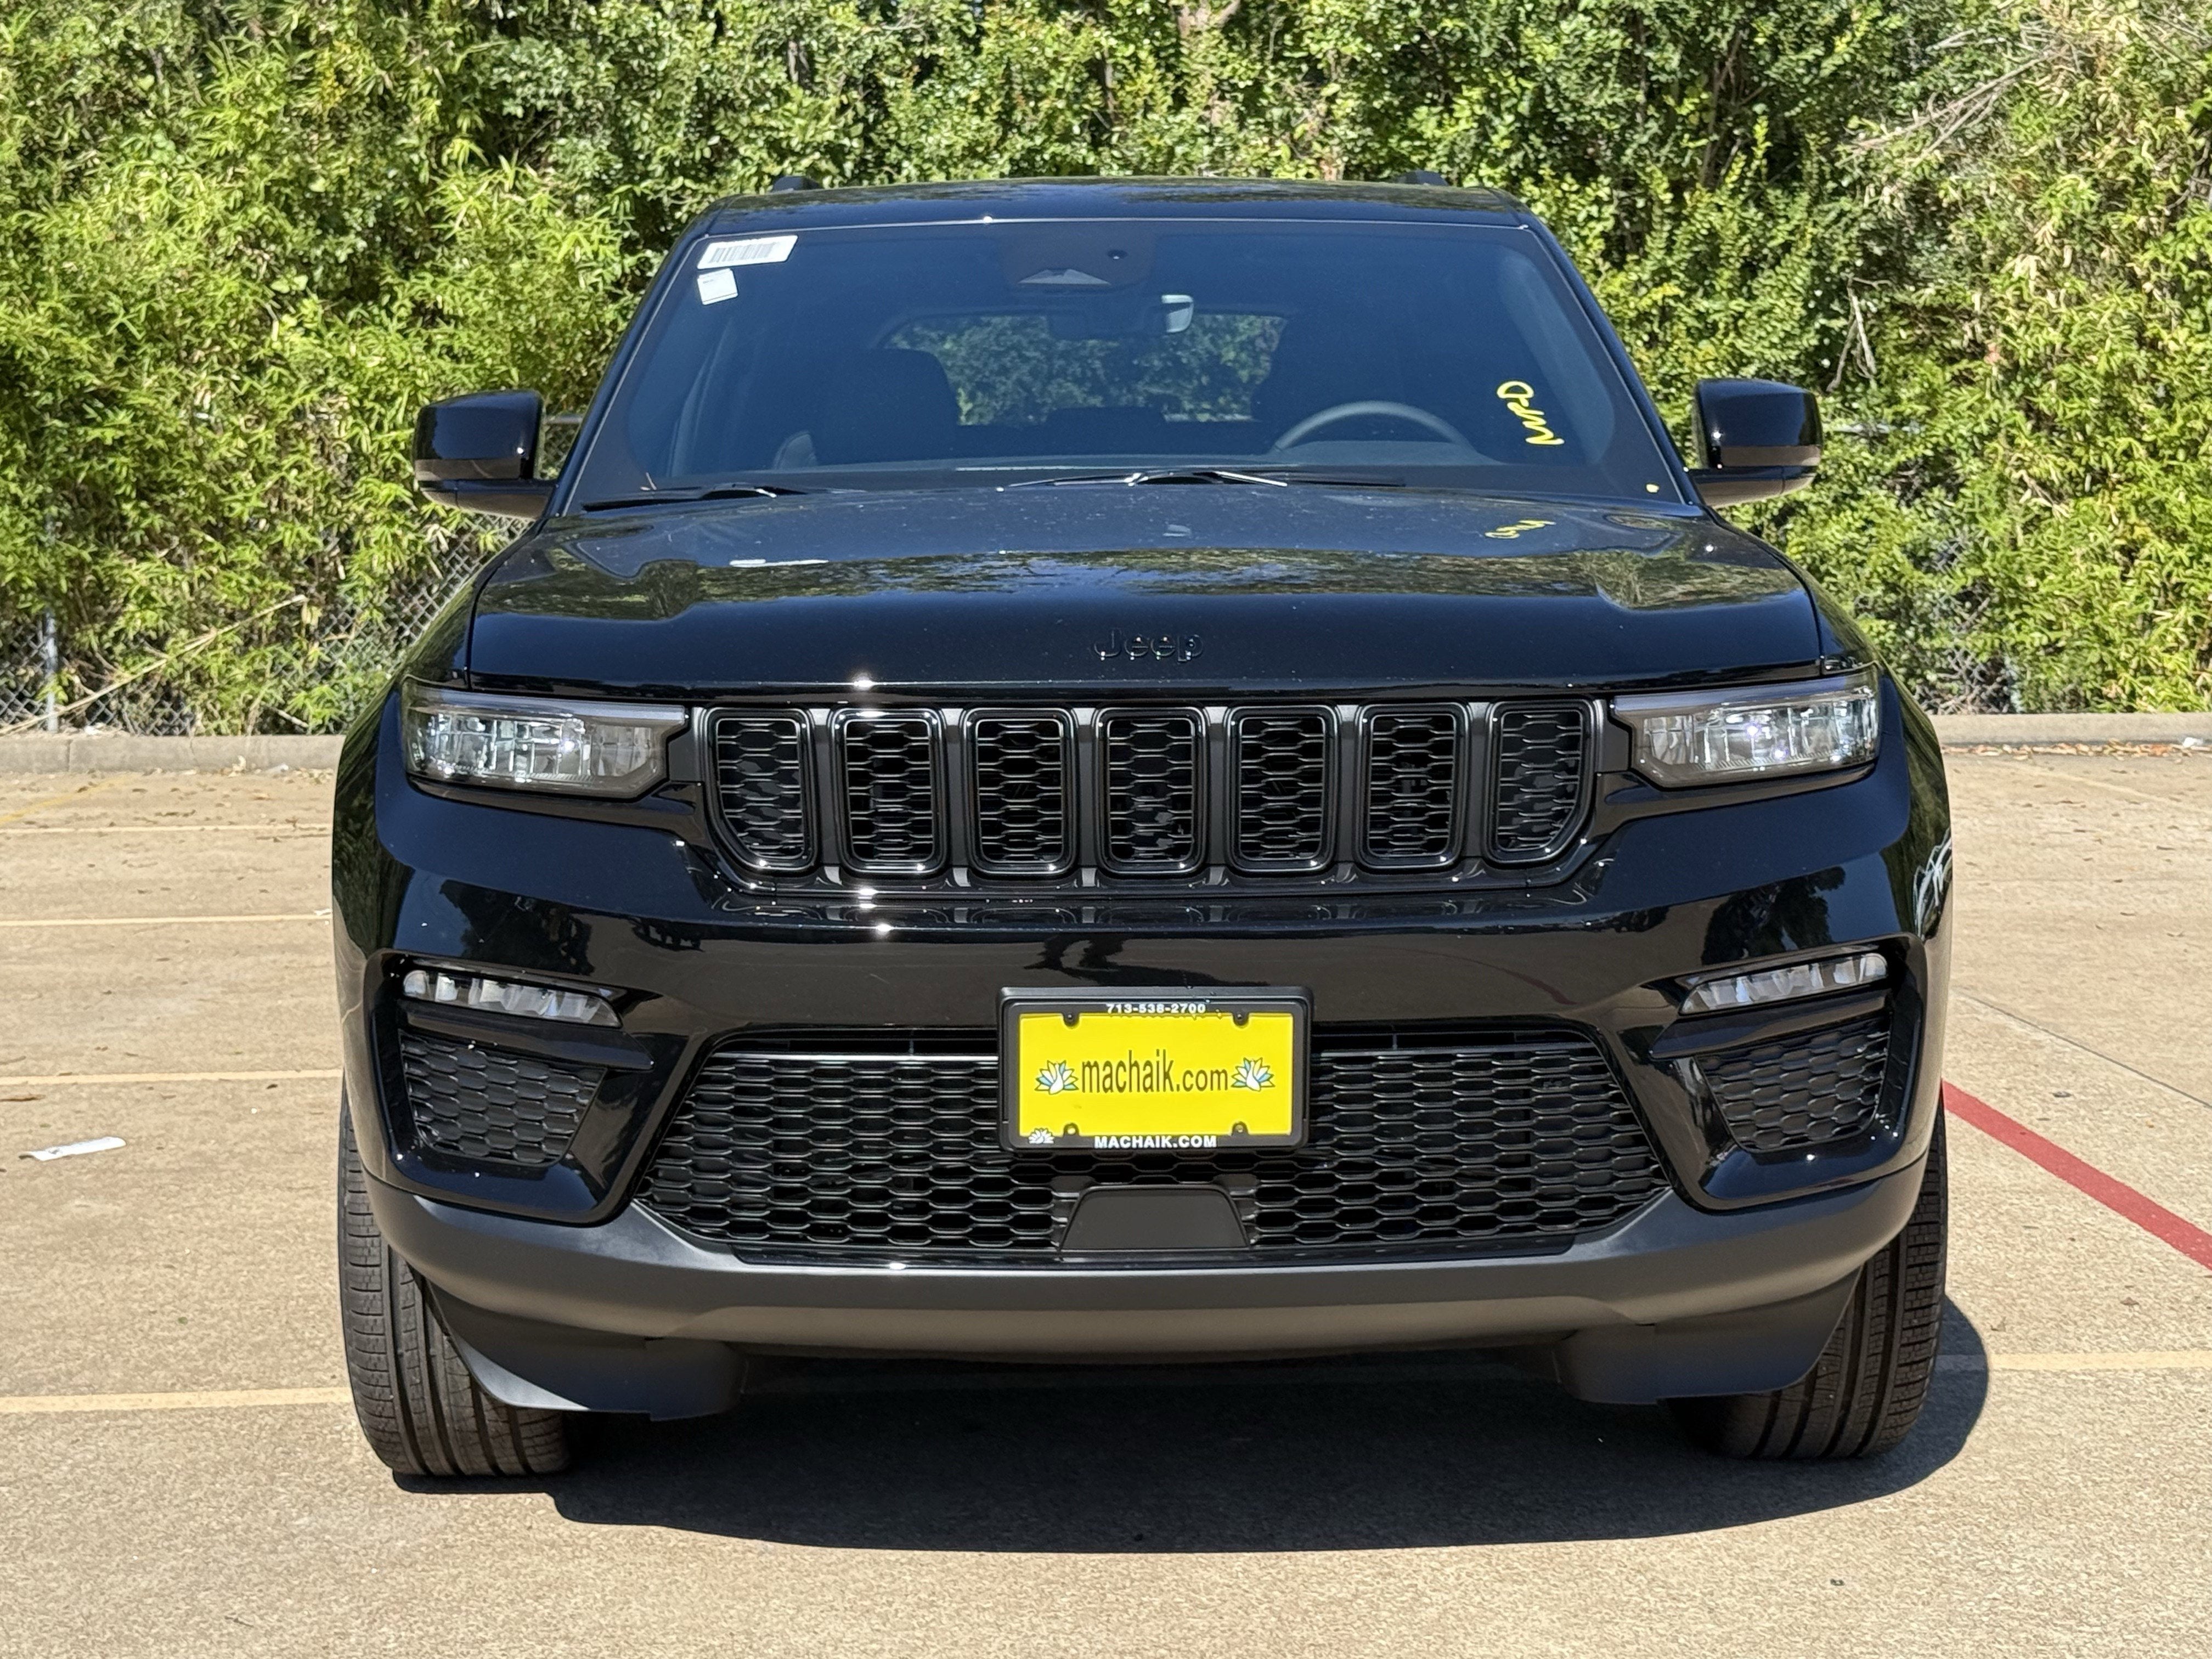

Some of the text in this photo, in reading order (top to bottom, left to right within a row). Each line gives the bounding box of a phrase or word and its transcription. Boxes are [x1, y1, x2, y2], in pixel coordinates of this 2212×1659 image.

[1094, 629, 1204, 663] Jeep
[1106, 1003, 1206, 1014] 713-538-2700
[1082, 1048, 1228, 1093] machaik.com
[1094, 1135, 1217, 1148] MACHAIK.COM
